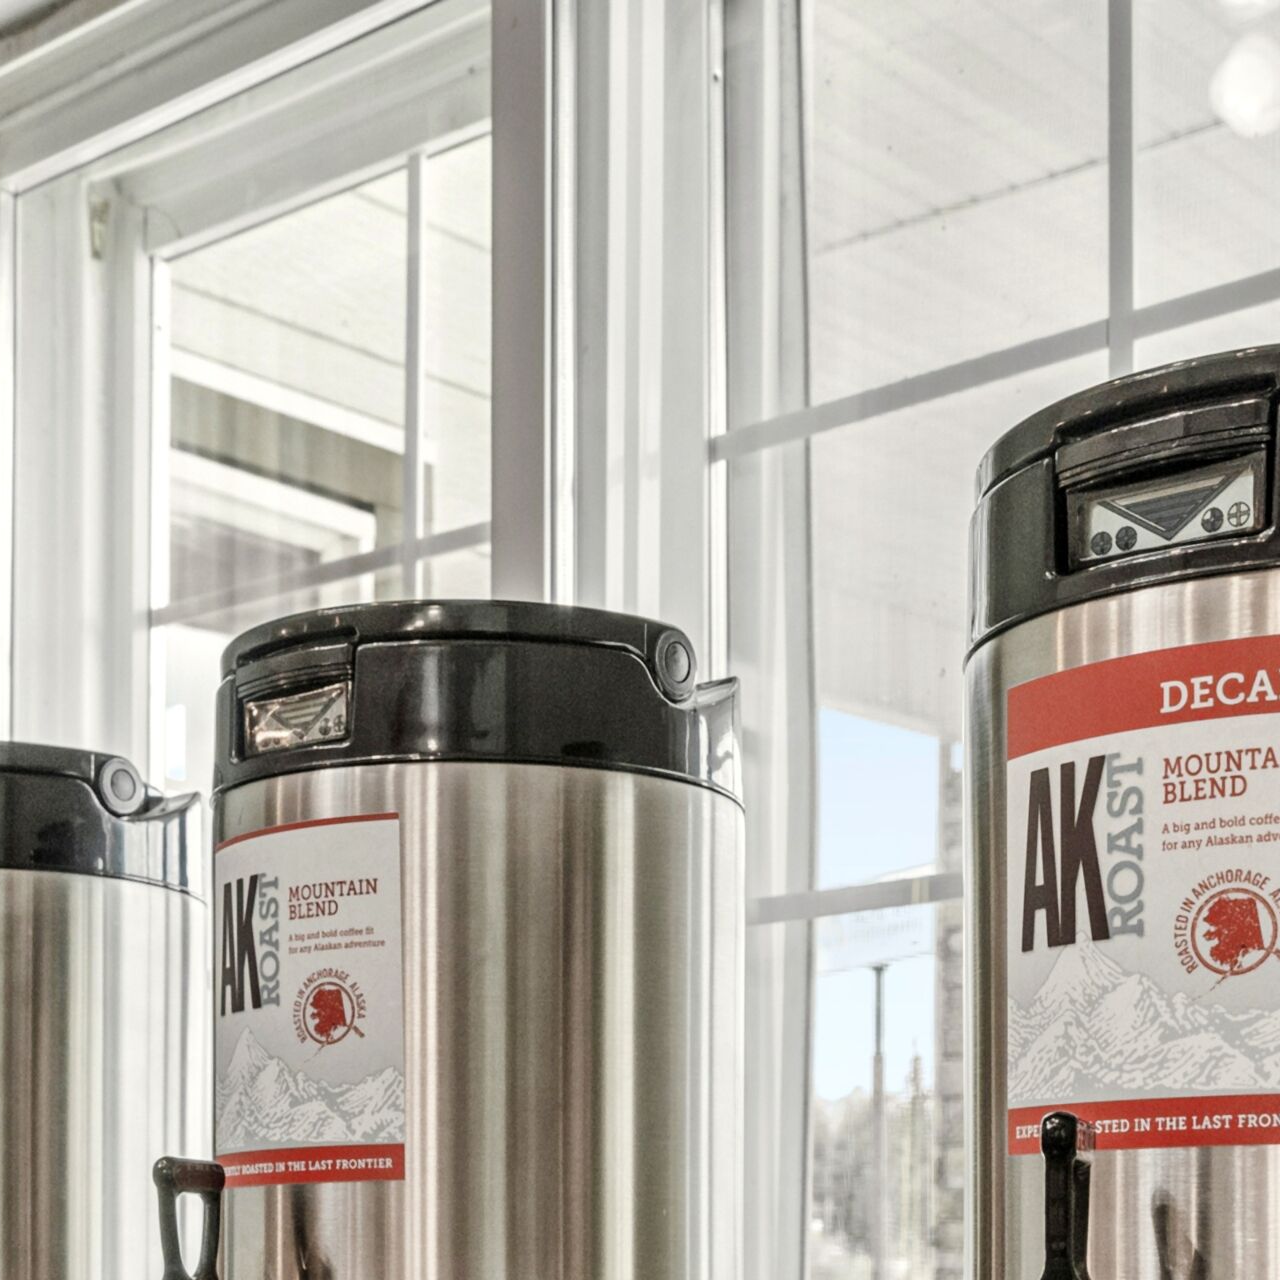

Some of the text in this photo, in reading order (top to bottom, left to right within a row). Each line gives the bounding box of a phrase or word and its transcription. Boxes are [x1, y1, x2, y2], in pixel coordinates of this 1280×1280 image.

[1162, 775, 1248, 804] BLEND
[1162, 823, 1170, 834] A
[1173, 822, 1191, 835] big
[1194, 818, 1216, 831] and
[1219, 816, 1246, 828] bold
[1021, 754, 1110, 952] AK
[1106, 752, 1144, 938] ROAST
[1162, 840, 1178, 851] for
[1181, 838, 1202, 850] any
[1205, 833, 1253, 847] Alaskan
[288, 878, 378, 902] MOUNTAIN
[1192, 869, 1271, 900] ANCHORAGE
[288, 900, 338, 920] BLEND
[1180, 898, 1195, 913] IN
[220, 874, 262, 1017] AK
[258, 872, 280, 1008] ROAST
[344, 940, 385, 949] adventure
[1174, 914, 1198, 974] ROASTED
[1094, 1118, 1129, 1134] STED
[1134, 1117, 1151, 1132] IN
[1155, 1116, 1187, 1131] THE
[1192, 1114, 1233, 1130] LAST
[275, 1161, 286, 1173] IN
[288, 1160, 306, 1172] THE
[308, 1159, 333, 1171] LAST
[336, 1157, 394, 1170] FRONTIER
